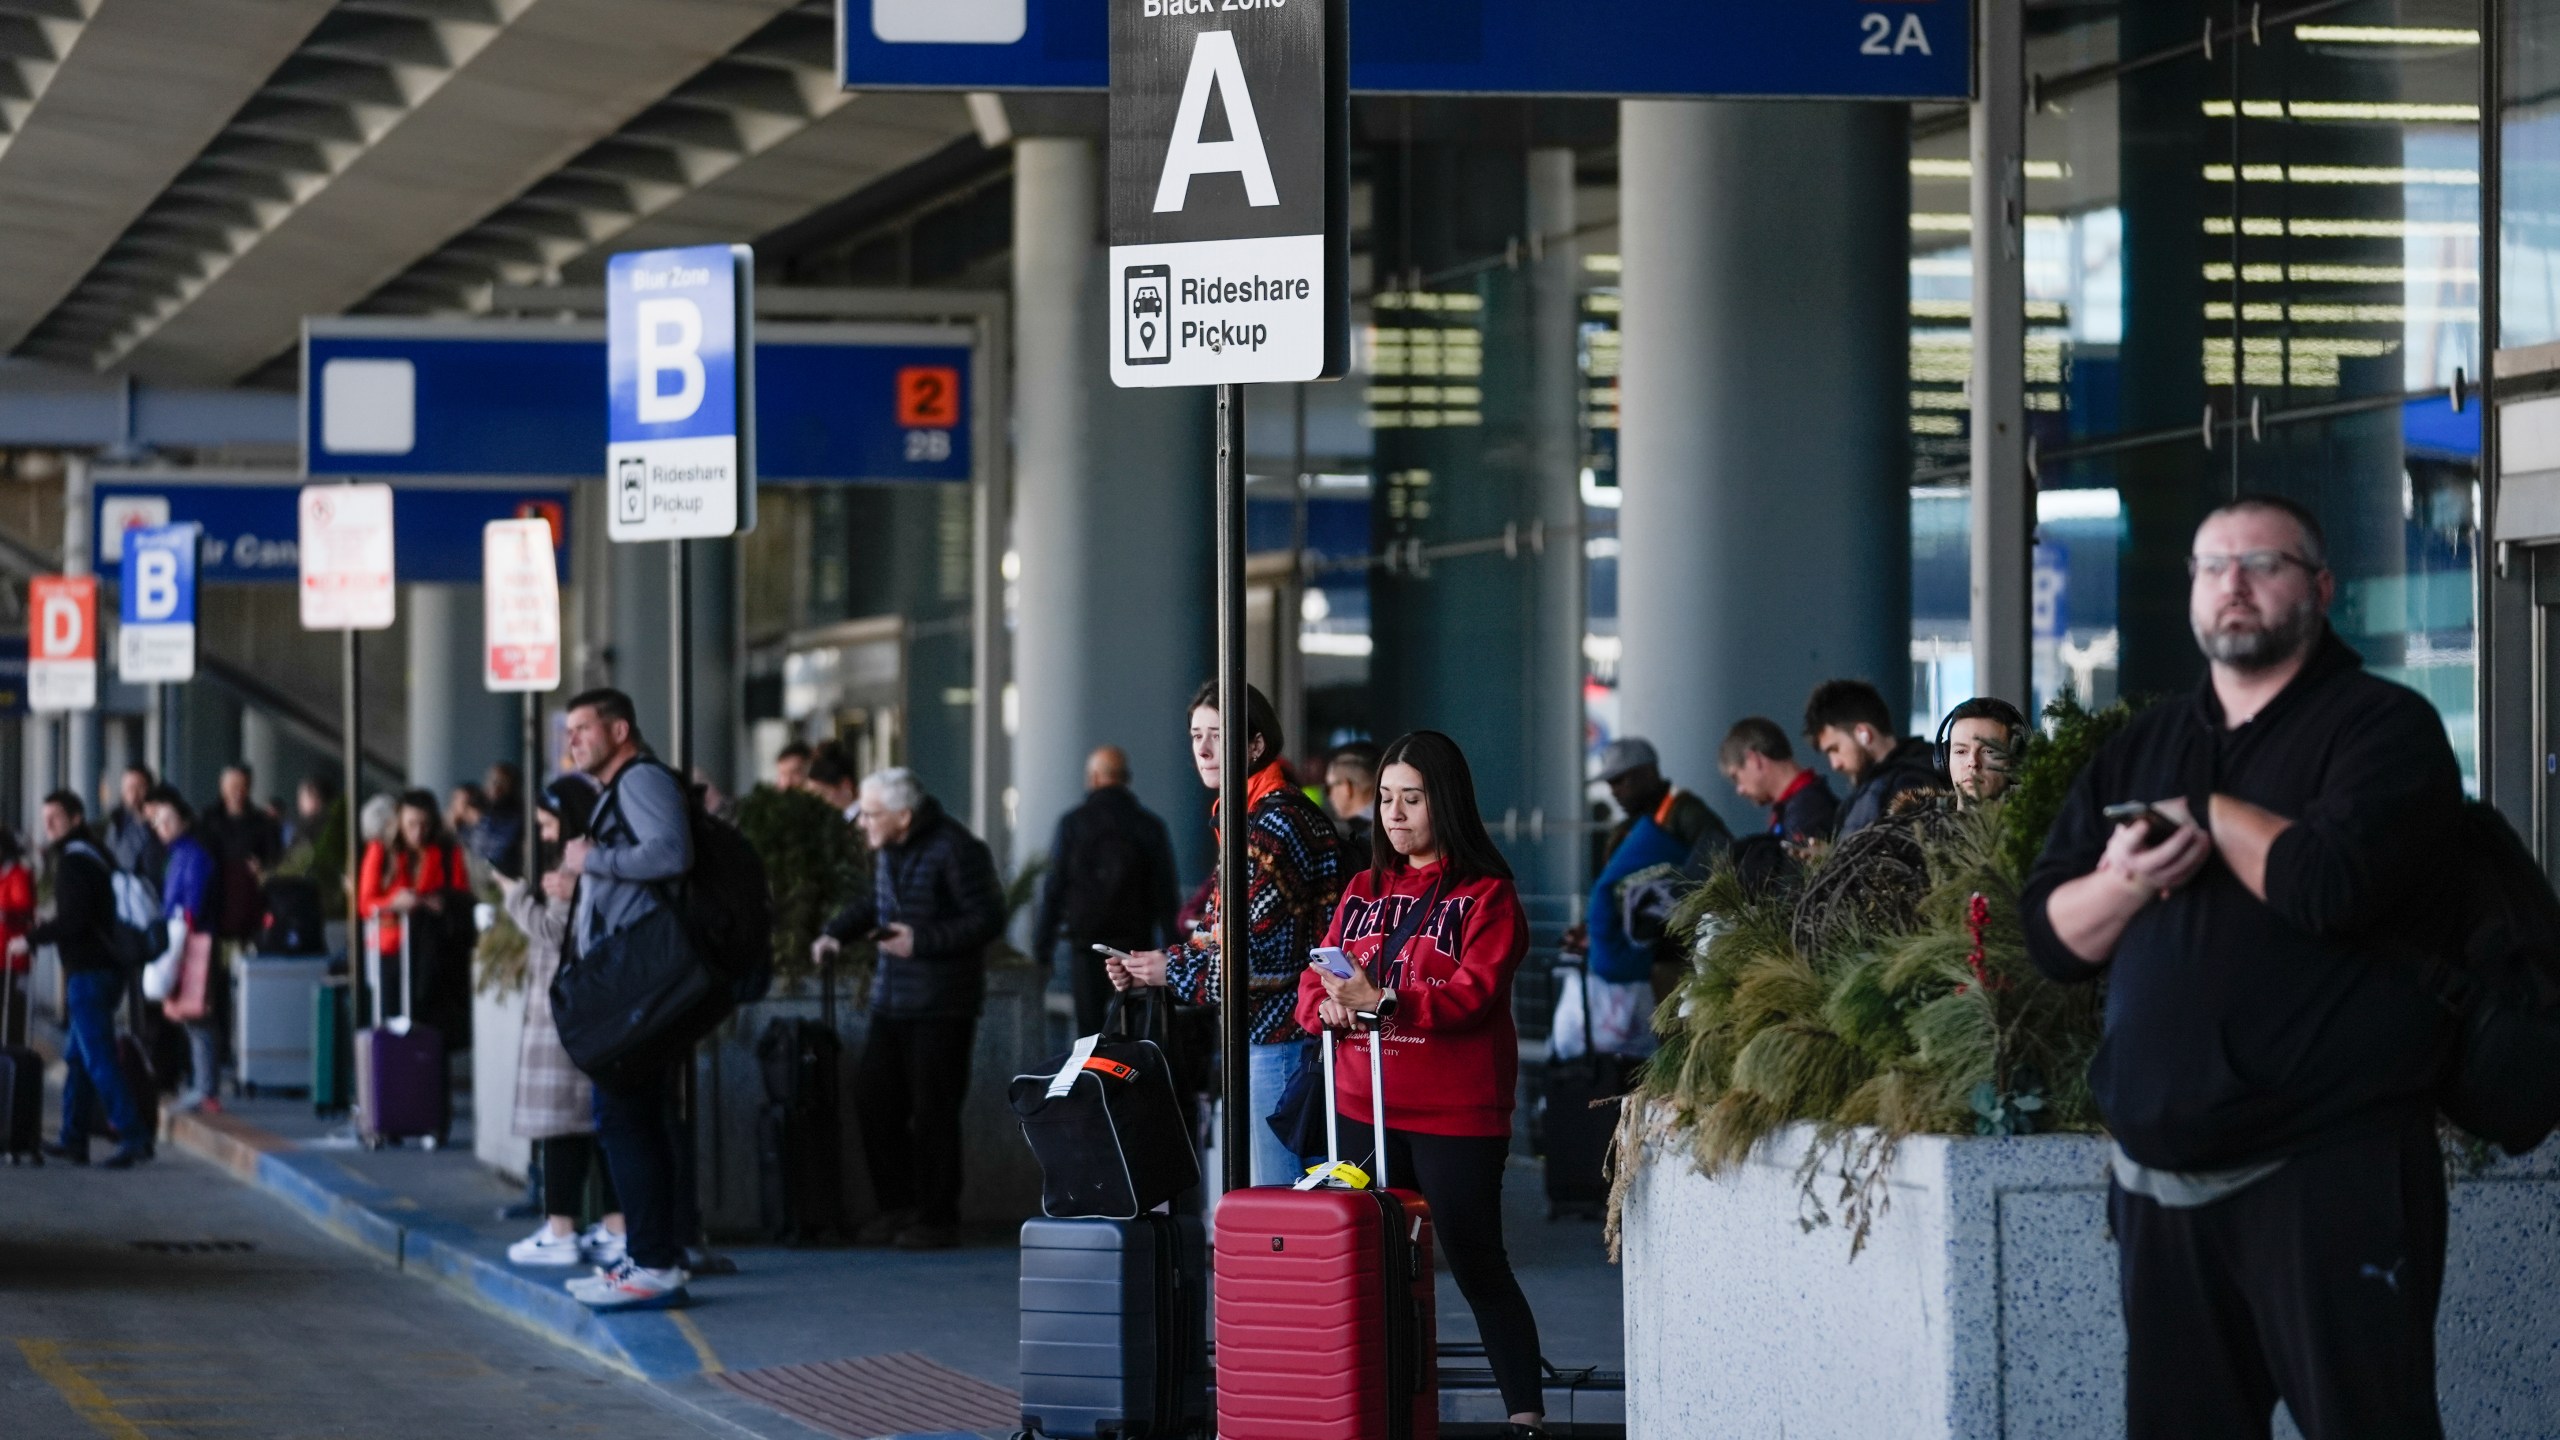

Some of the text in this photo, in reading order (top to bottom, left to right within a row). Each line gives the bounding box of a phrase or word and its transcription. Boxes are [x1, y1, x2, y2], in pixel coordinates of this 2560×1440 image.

[1859, 12, 1932, 56] 2A
[1153, 30, 1280, 213] A
[631, 266, 709, 292] Blue Zone
[1181, 273, 1310, 305] Rideshare
[1181, 321, 1267, 352] Pickup
[637, 298, 706, 424] B
[913, 374, 945, 415] 2
[652, 464, 727, 483] Rideshare
[652, 493, 703, 513] Pickup
[233, 532, 298, 568] Can
[136, 549, 179, 620] B
[42, 597, 82, 657] D
[1380, 1022, 1426, 1044] Dreams
